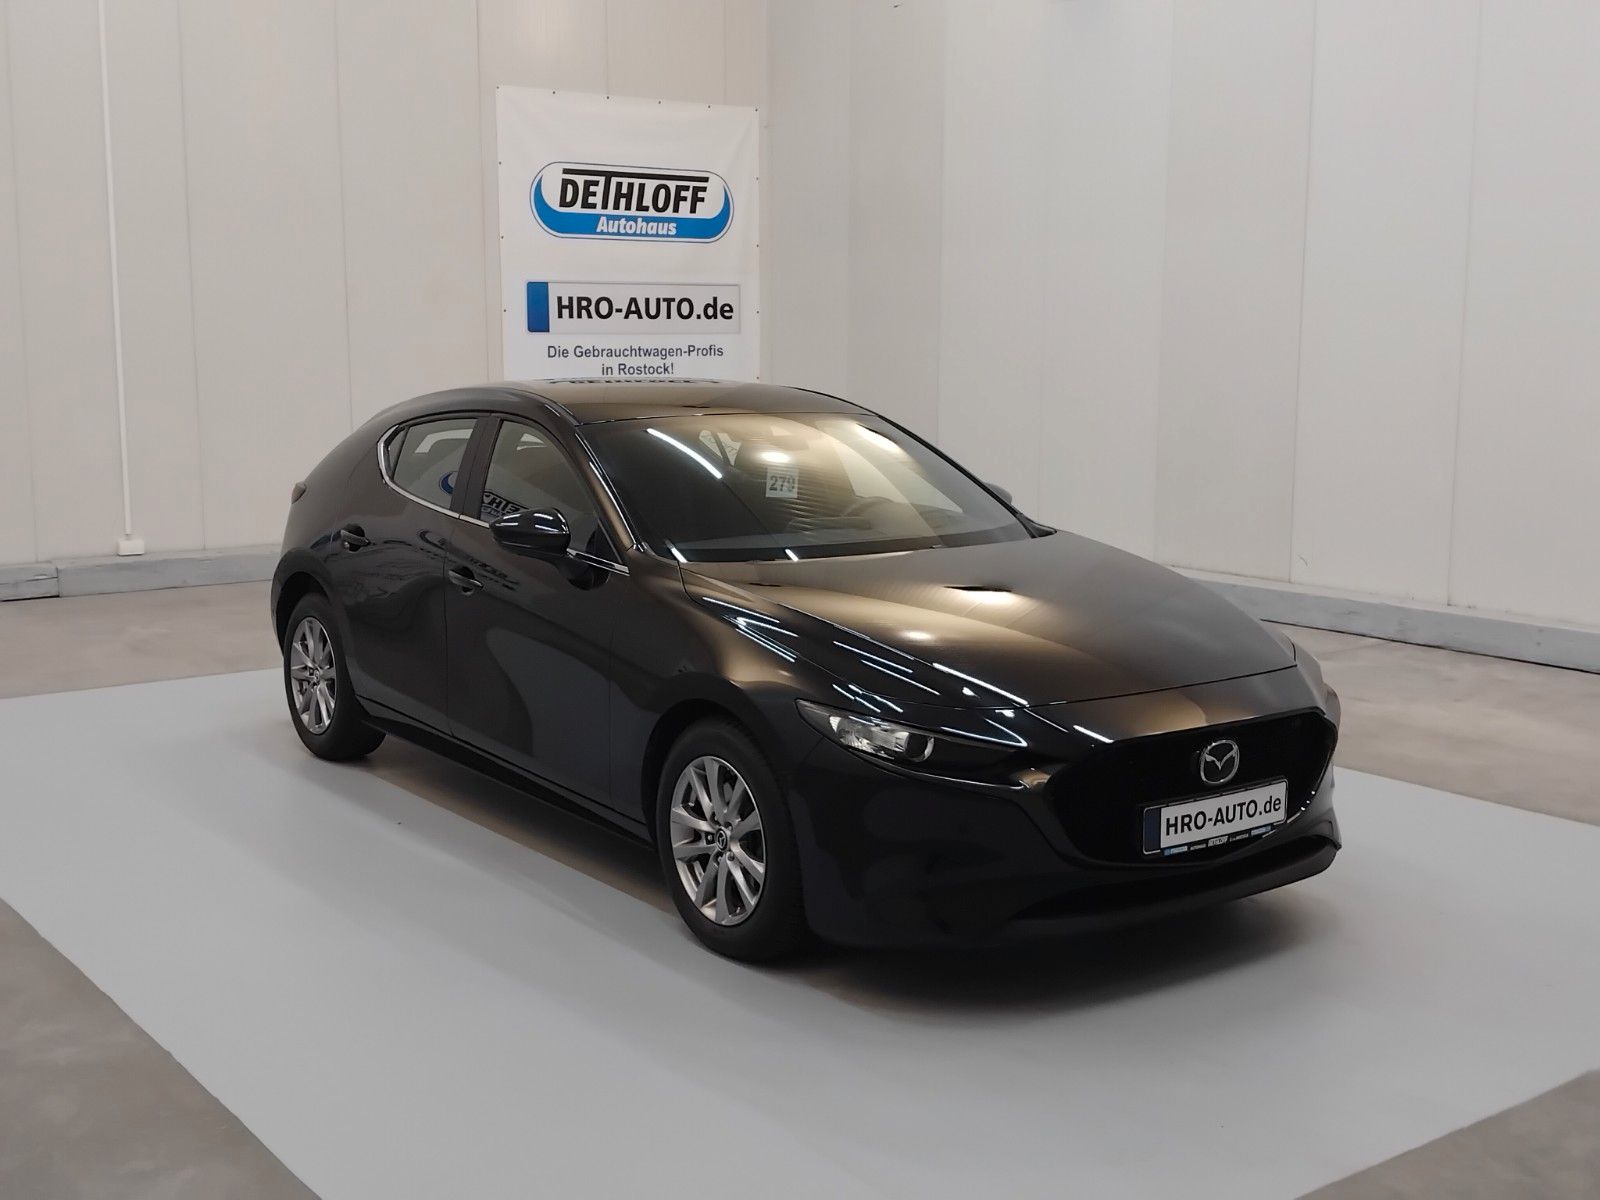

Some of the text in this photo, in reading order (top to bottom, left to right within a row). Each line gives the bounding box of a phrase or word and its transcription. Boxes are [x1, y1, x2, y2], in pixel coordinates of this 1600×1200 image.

[559, 168, 709, 214] DETHLOFF
[596, 216, 677, 235] Autohaus
[557, 296, 734, 320] HRO-AUTO.de
[547, 345, 724, 361] Die Gebrauchtwagen-Profis
[601, 363, 674, 375] in Rostock!
[1165, 795, 1282, 837] HRO-AUTO.de
